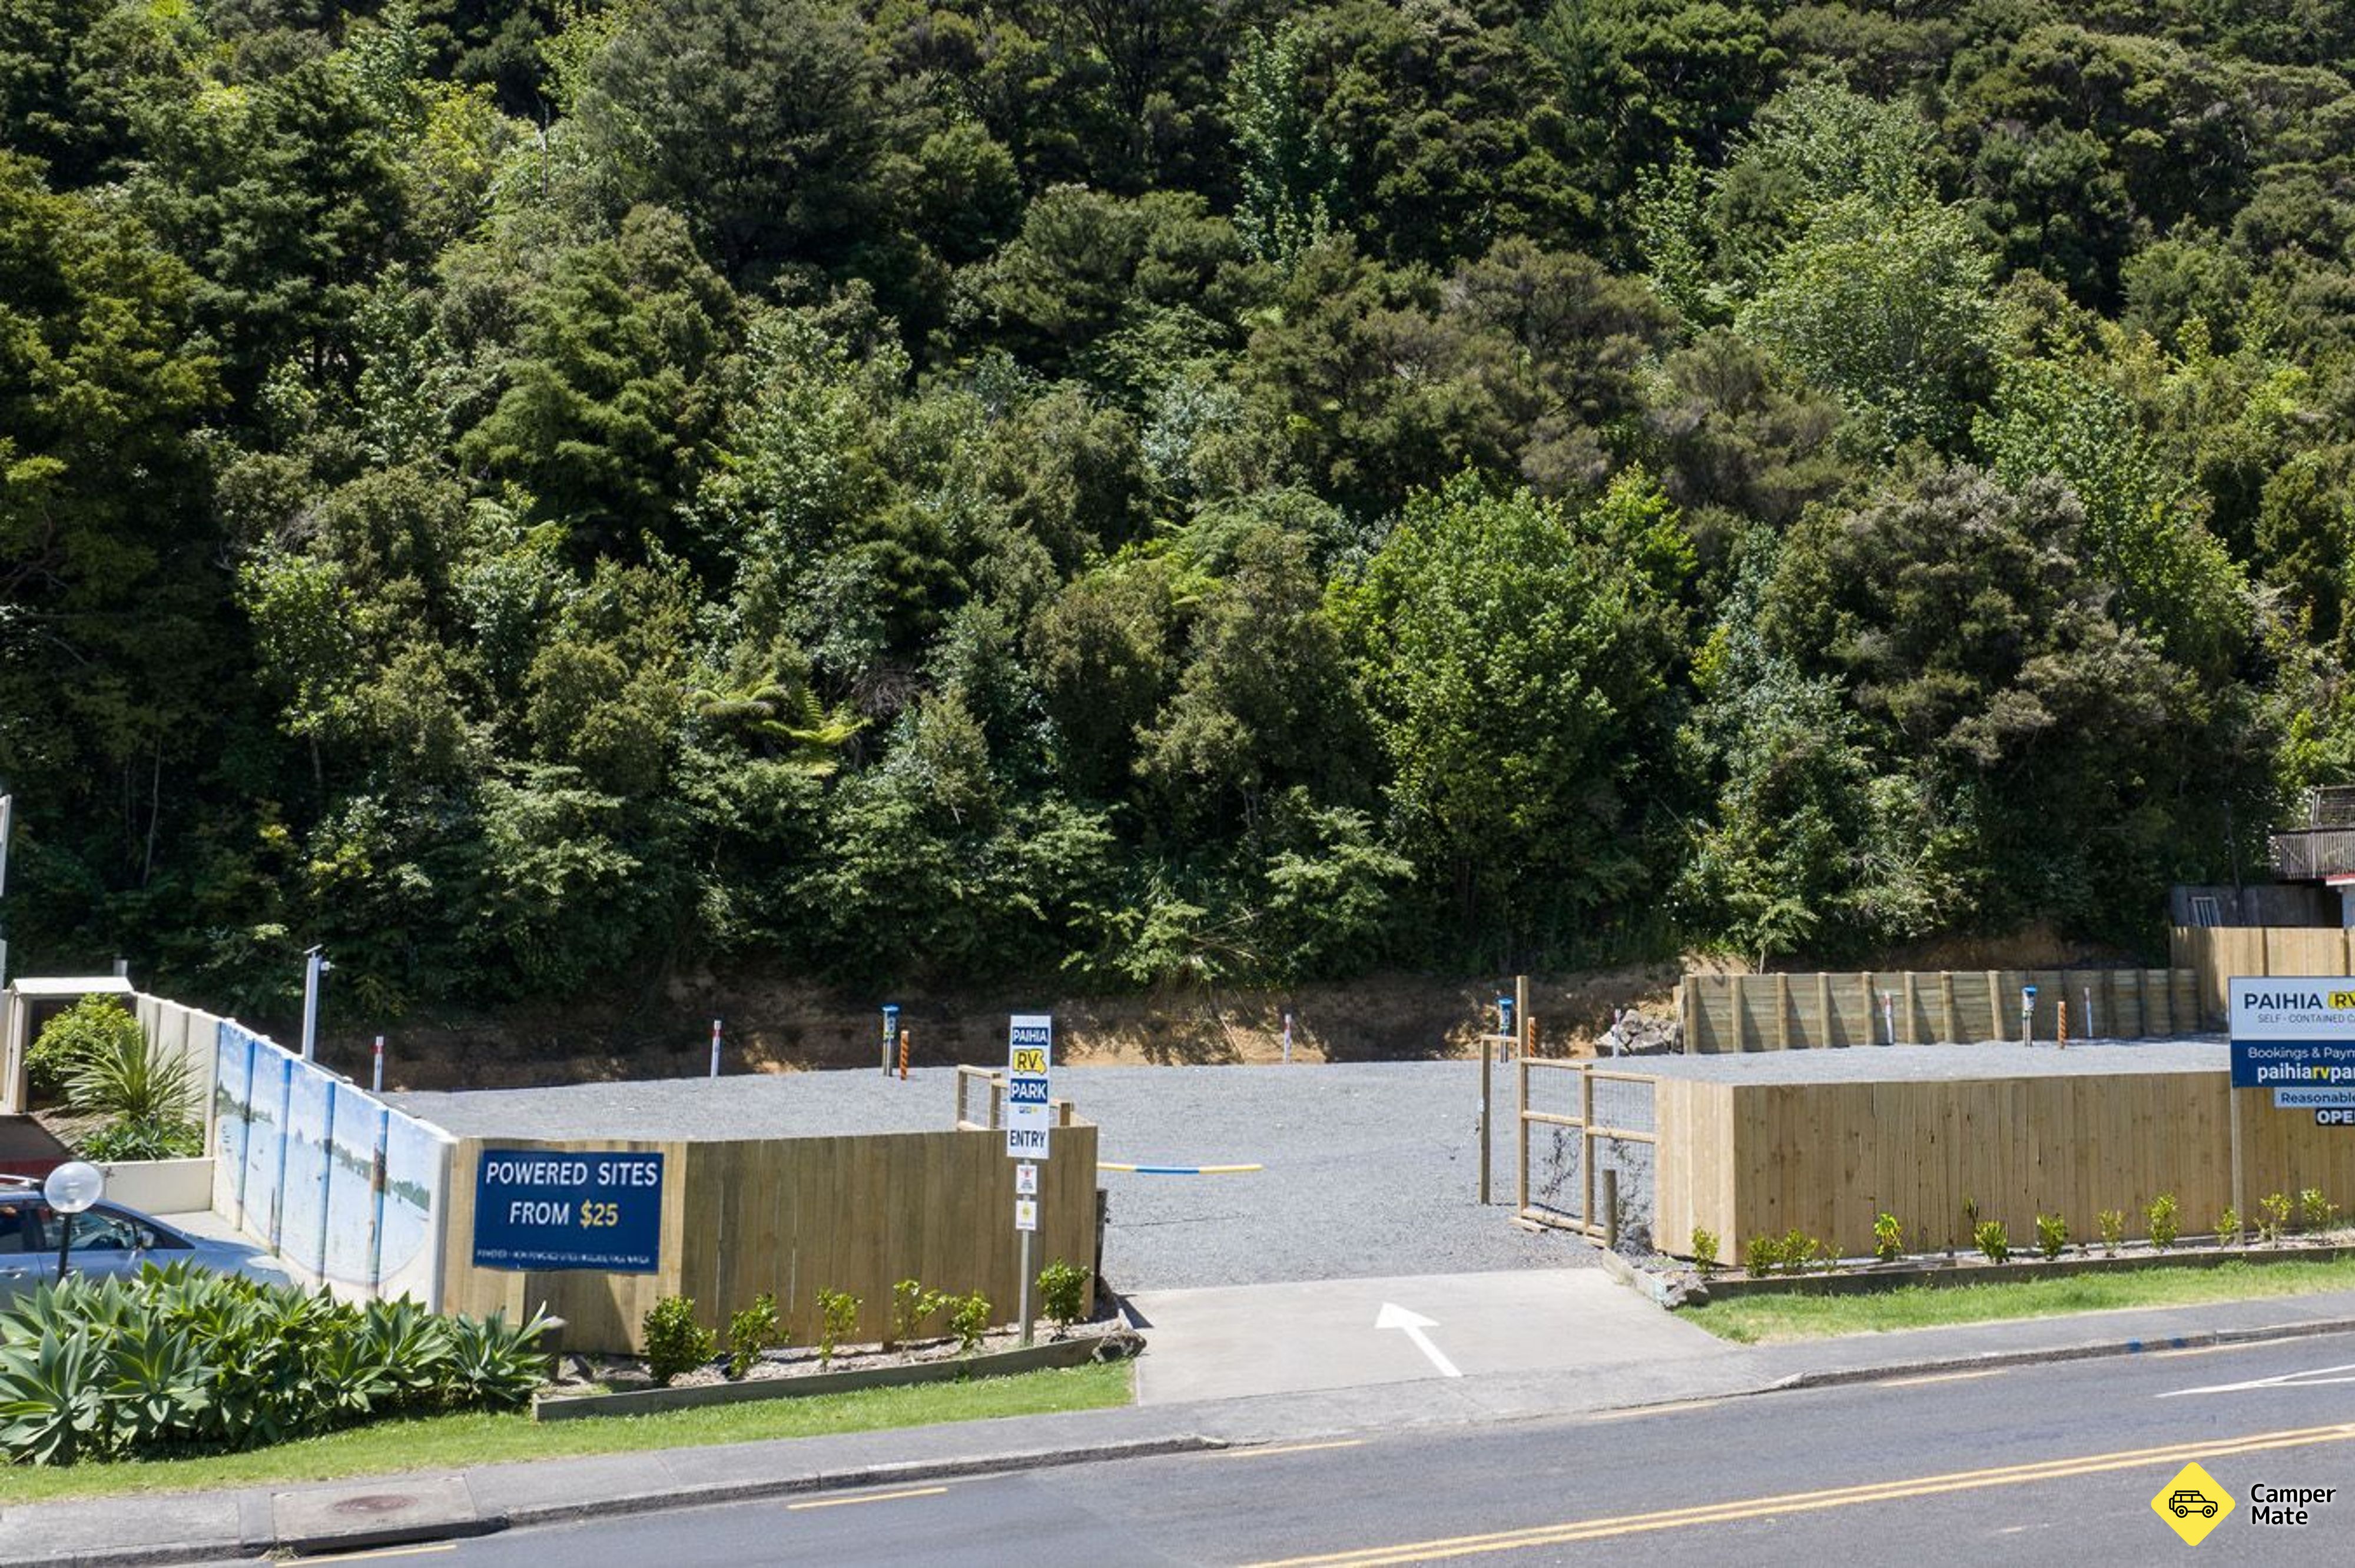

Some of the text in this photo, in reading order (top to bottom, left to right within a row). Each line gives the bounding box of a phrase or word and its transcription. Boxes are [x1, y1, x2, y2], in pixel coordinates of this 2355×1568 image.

[2244, 993, 2323, 1009] PAIHIA
[1013, 1029, 1047, 1042] PAIHIA
[1017, 1052, 1039, 1069] RV
[2248, 1047, 2308, 1060] Bookings
[2312, 1047, 2321, 1058] &
[1011, 1082, 1046, 1099] PARK
[2317, 1110, 2355, 1124] OPE
[1010, 1130, 1046, 1148] ENTRY
[486, 1162, 658, 1186] POWERED SITES
[510, 1199, 619, 1229] FROM $25
